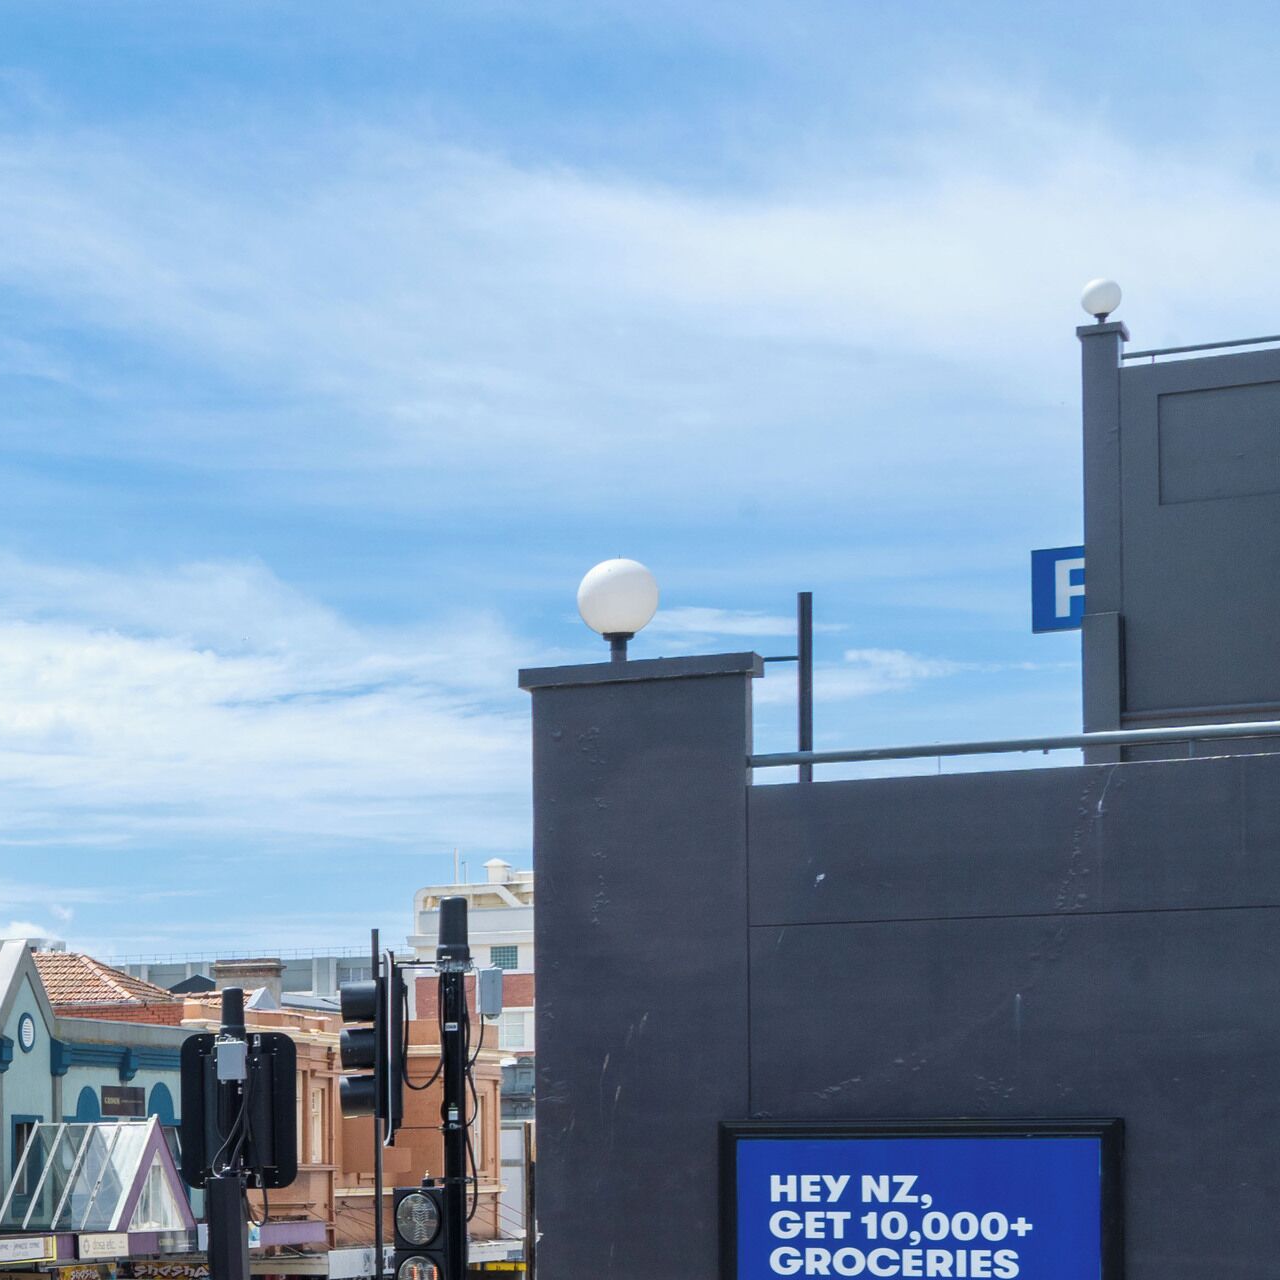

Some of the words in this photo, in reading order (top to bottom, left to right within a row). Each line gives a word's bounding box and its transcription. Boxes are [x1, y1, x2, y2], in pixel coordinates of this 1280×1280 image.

[770, 1174, 851, 1203] HEY
[861, 1174, 933, 1209] NZ,
[769, 1210, 852, 1239] GET
[861, 1211, 1033, 1246] 10,000+
[769, 1246, 1020, 1279] GROCERIES
